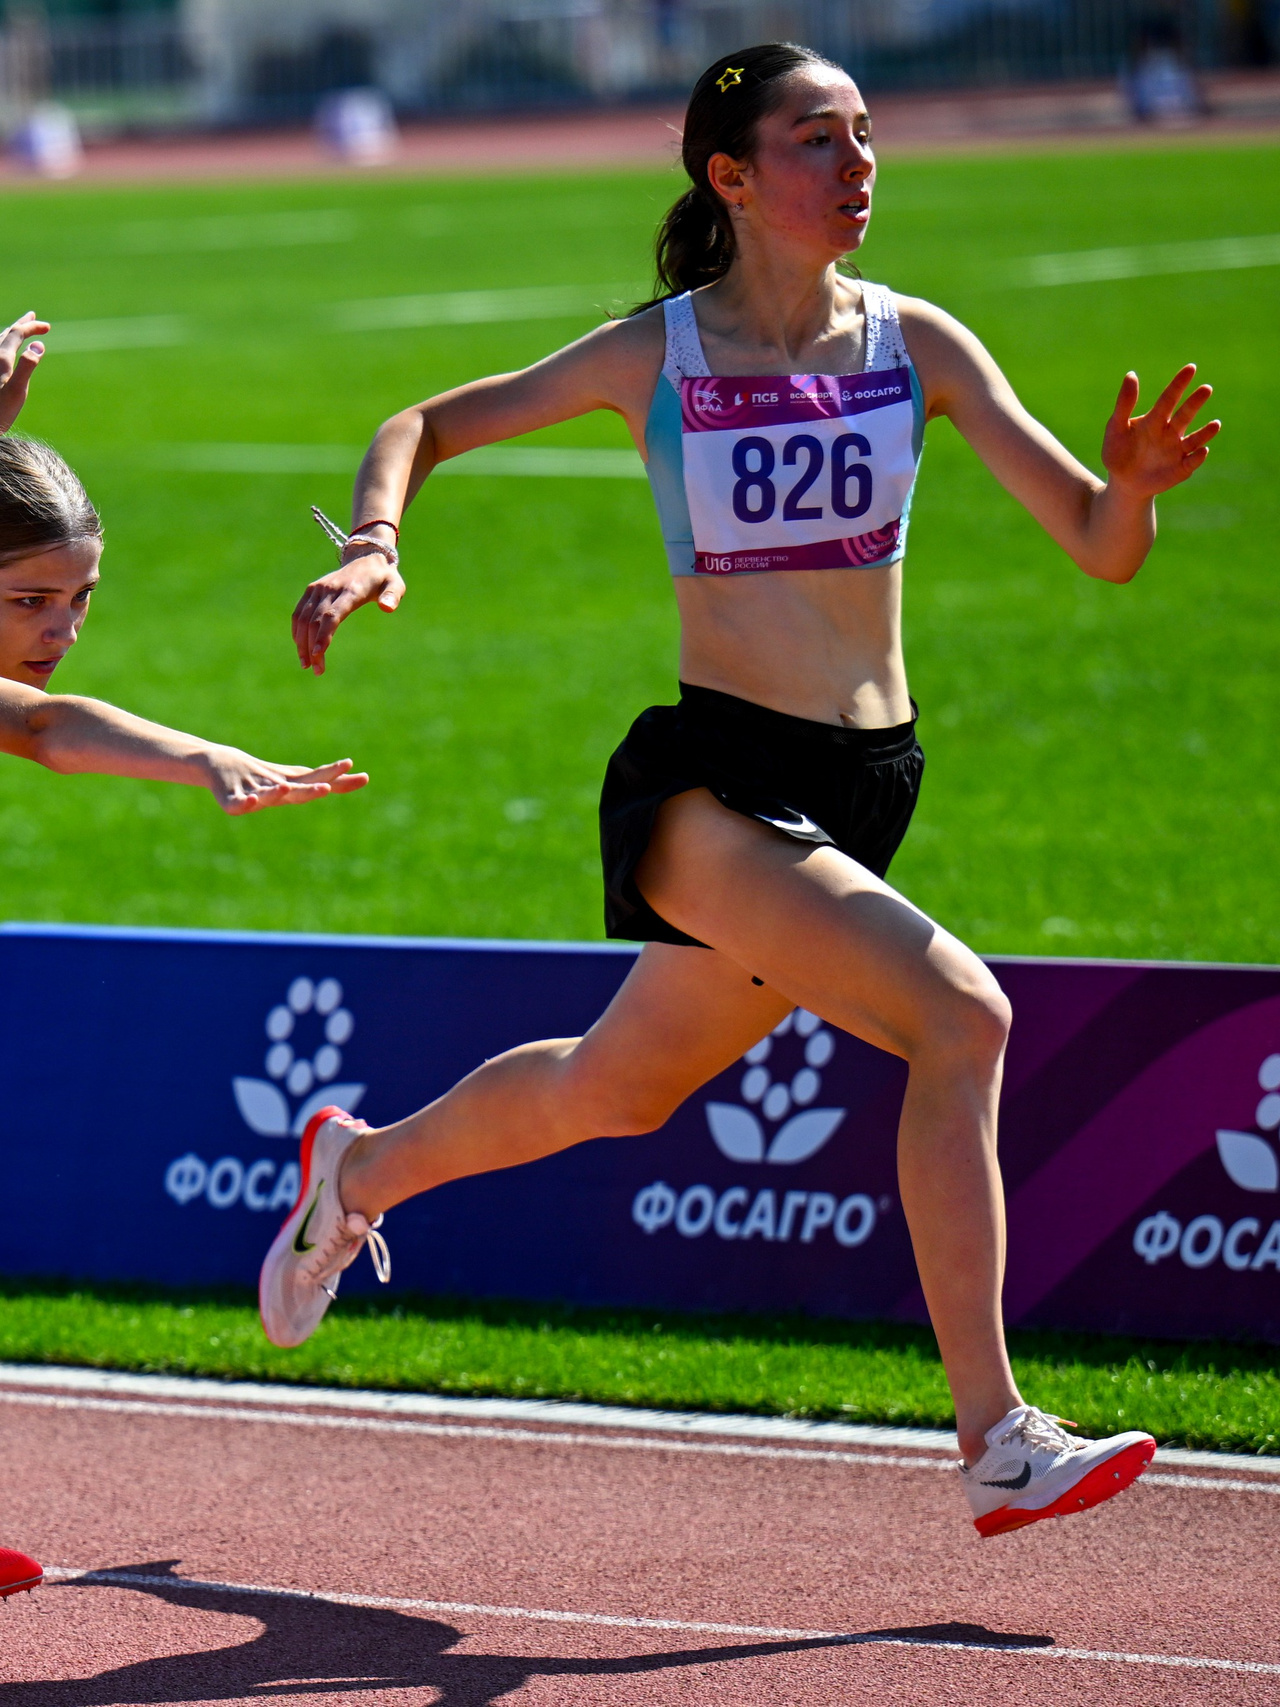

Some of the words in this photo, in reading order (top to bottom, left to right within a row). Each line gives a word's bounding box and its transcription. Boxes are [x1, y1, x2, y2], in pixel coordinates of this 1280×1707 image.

[752, 392, 779, 403] ПСБ
[854, 386, 901, 400] ФОСАГРО
[695, 404, 722, 412] ВФЛА
[732, 433, 872, 524] 826
[705, 556, 732, 571] U16
[735, 555, 789, 564] ПЕРВЕНСТВО
[735, 562, 769, 570] РОССИИ
[165, 1153, 301, 1212] ФОСА
[632, 1180, 876, 1247] ФОСАГРО
